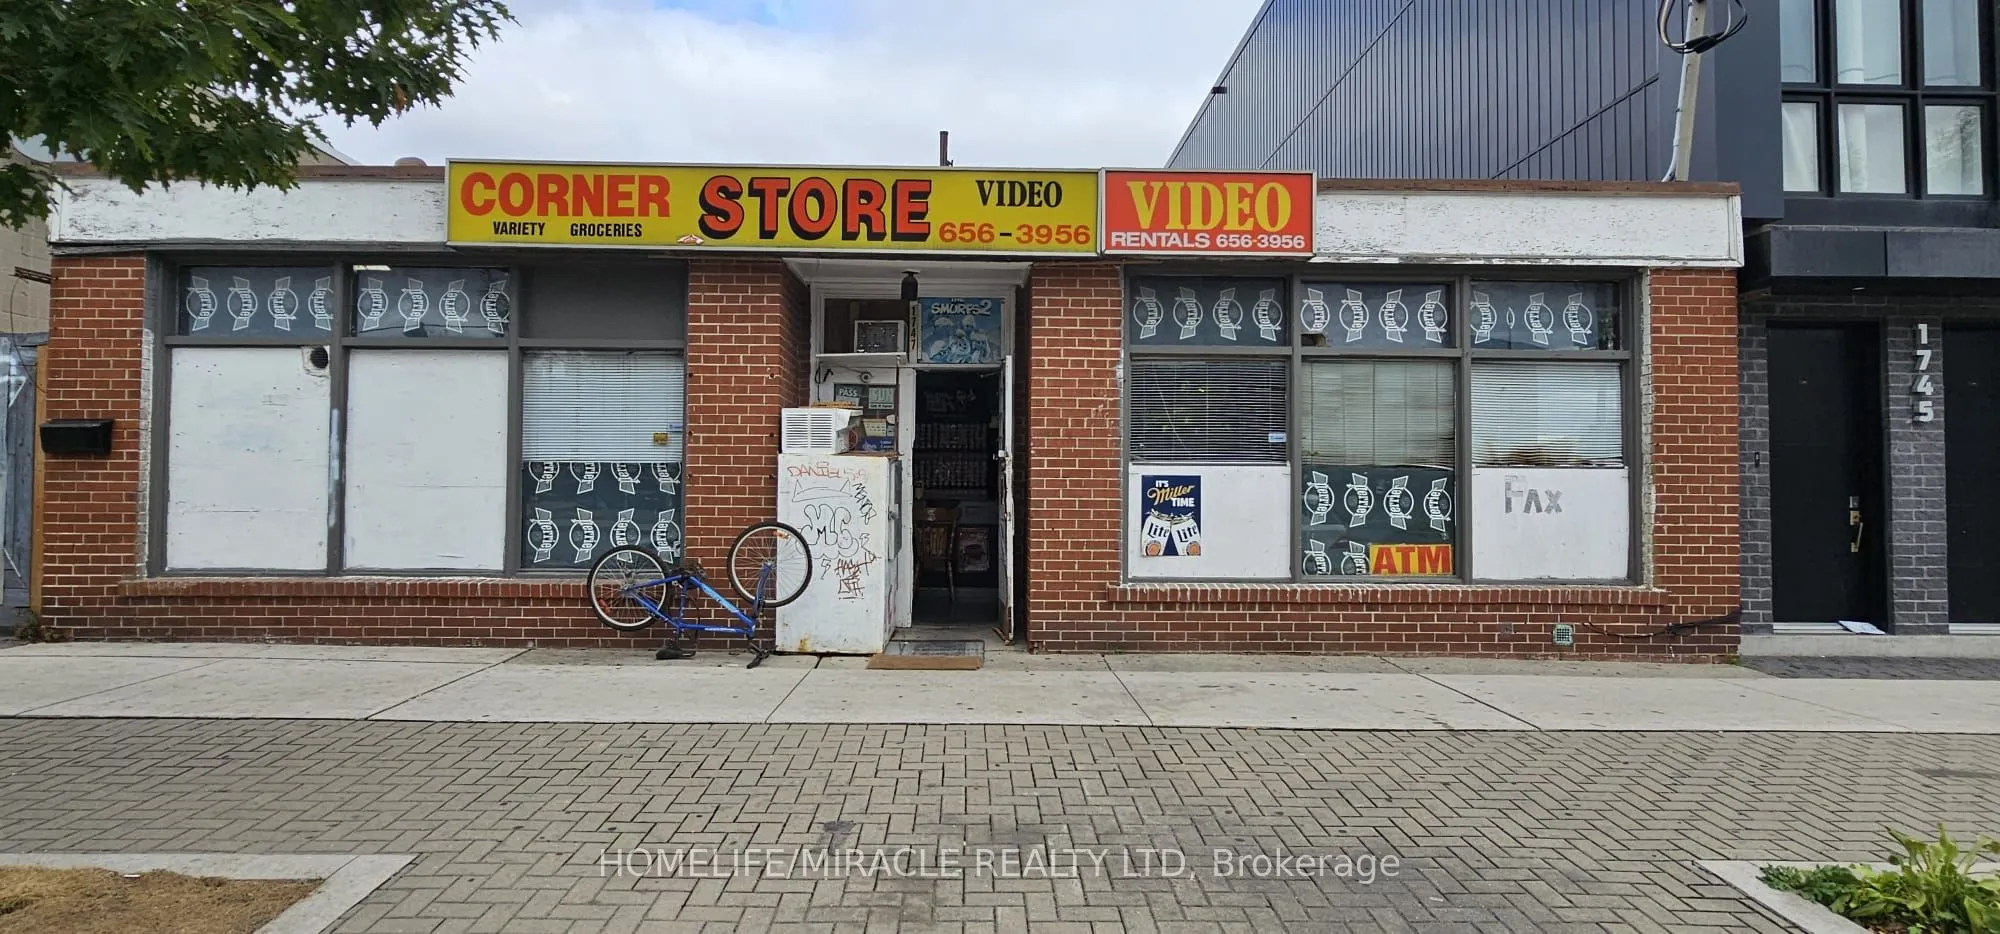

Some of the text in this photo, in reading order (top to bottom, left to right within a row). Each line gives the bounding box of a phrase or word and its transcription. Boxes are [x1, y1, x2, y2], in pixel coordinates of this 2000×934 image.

[976, 180, 1063, 208] VIDEO
[460, 171, 932, 242] CORNER STORE
[1126, 180, 1292, 233] VIDEO
[493, 221, 642, 238] VARIETY GROCERIES
[1111, 232, 1306, 249] RENTALS 656-3956
[931, 300, 993, 316] SMURFS 2
[1915, 323, 1935, 422] 1745
[1147, 485, 1195, 505] Miller
[1172, 498, 1195, 507] TIME
[1148, 523, 1170, 539] Lite
[1176, 523, 1198, 542] Lite
[1372, 546, 1451, 575] ATM
